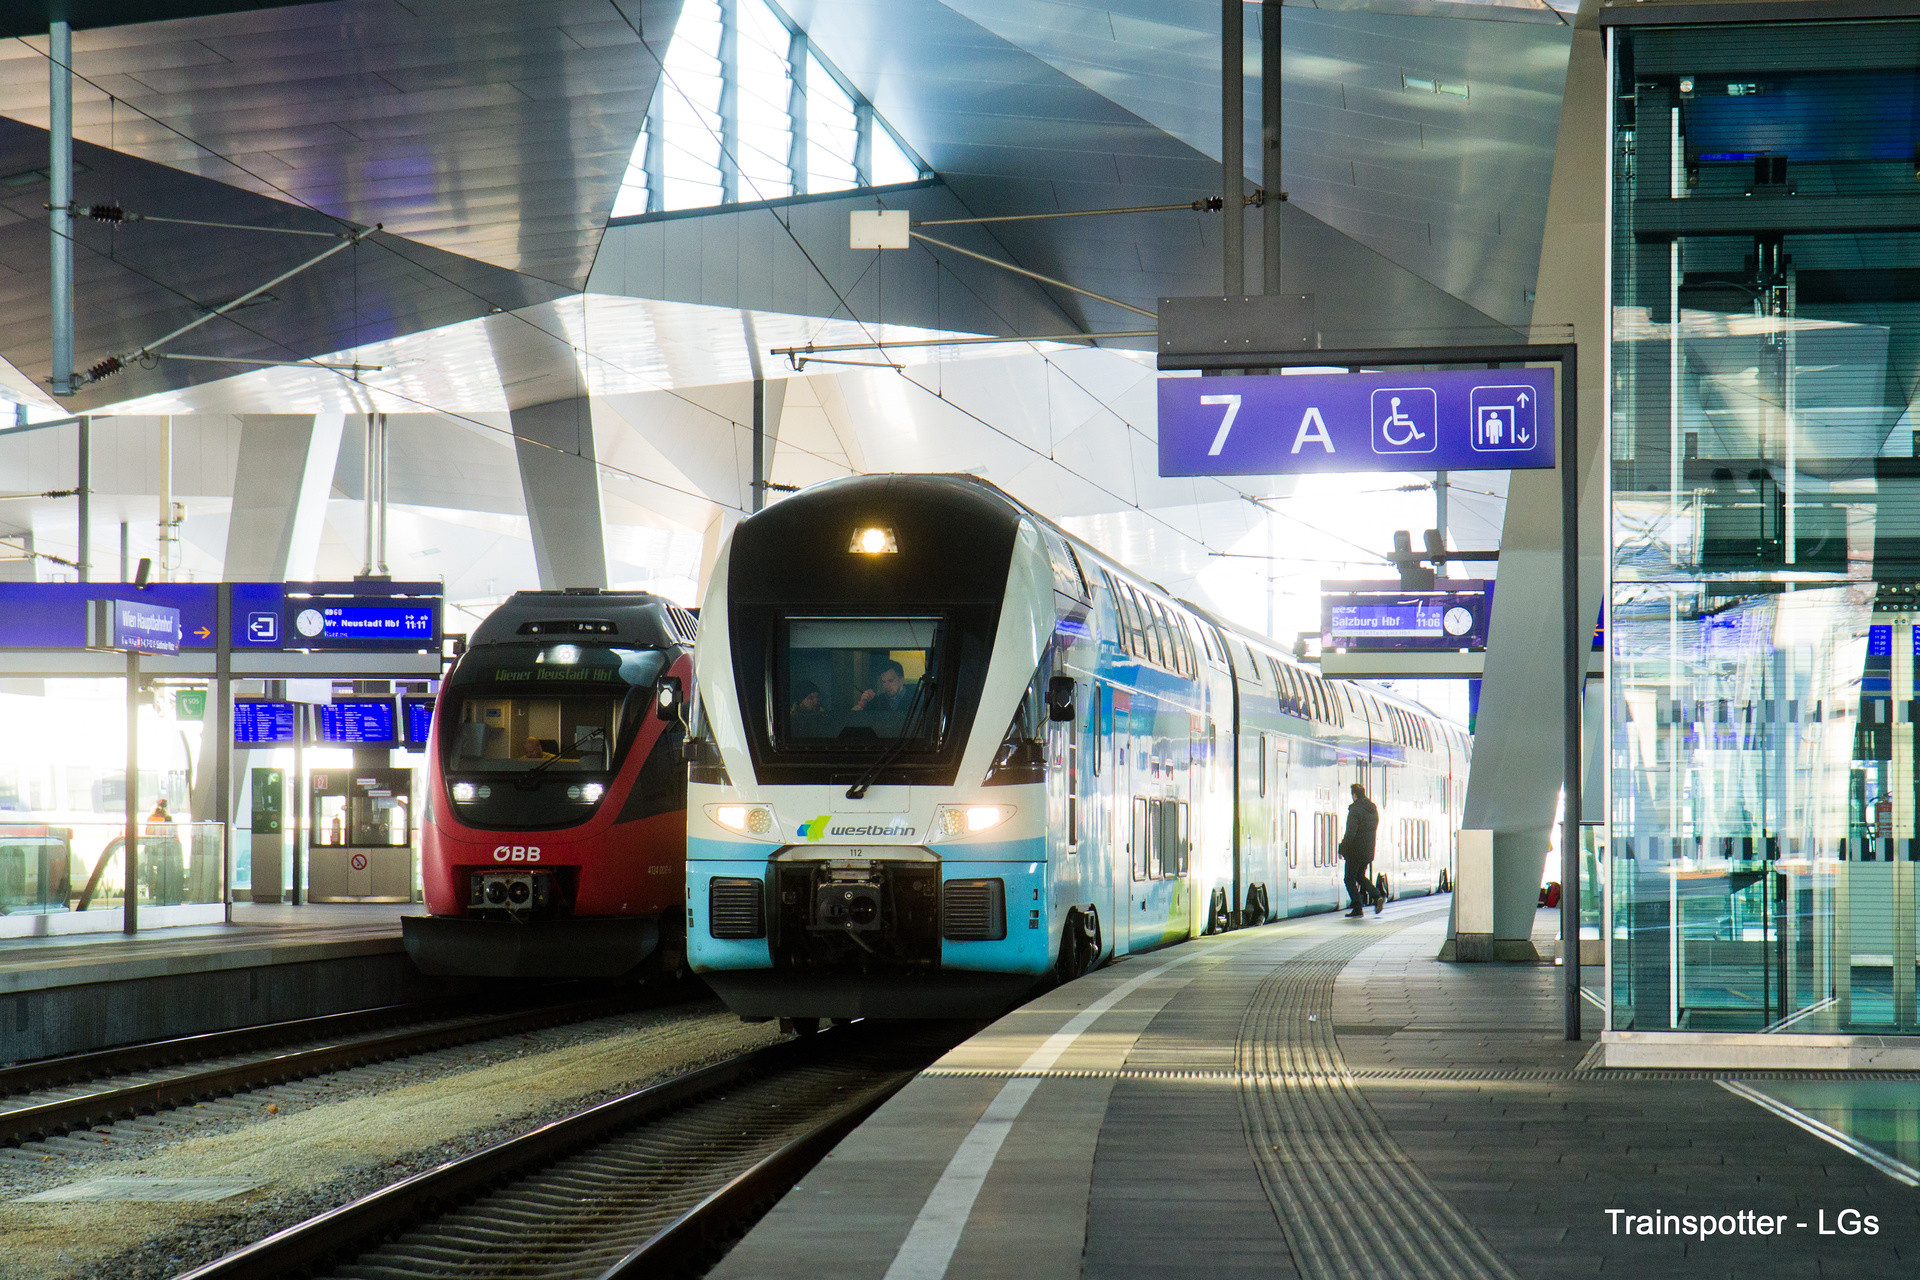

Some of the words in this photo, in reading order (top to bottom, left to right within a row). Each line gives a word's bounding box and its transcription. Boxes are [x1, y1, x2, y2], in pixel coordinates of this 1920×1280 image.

[1200, 394, 1242, 456] 7
[1290, 407, 1336, 454] A
[122, 610, 137, 628] Wien
[137, 612, 173, 634] Hauptbahnhof
[324, 619, 339, 627] Wr.
[341, 619, 382, 628] Neustadt
[385, 619, 400, 628] Hbf
[405, 620, 426, 630] 11:11
[1332, 616, 1378, 628] Salzburg
[1382, 616, 1400, 626] Hbf
[1416, 618, 1440, 628] 11:06
[495, 668, 533, 681] Wiener
[537, 667, 589, 681] Neustadt
[592, 668, 612, 681] Hbf
[188, 697, 200, 705] SOS
[831, 825, 916, 836] westbahn
[493, 845, 541, 862] ÖBB
[850, 849, 862, 857] 112
